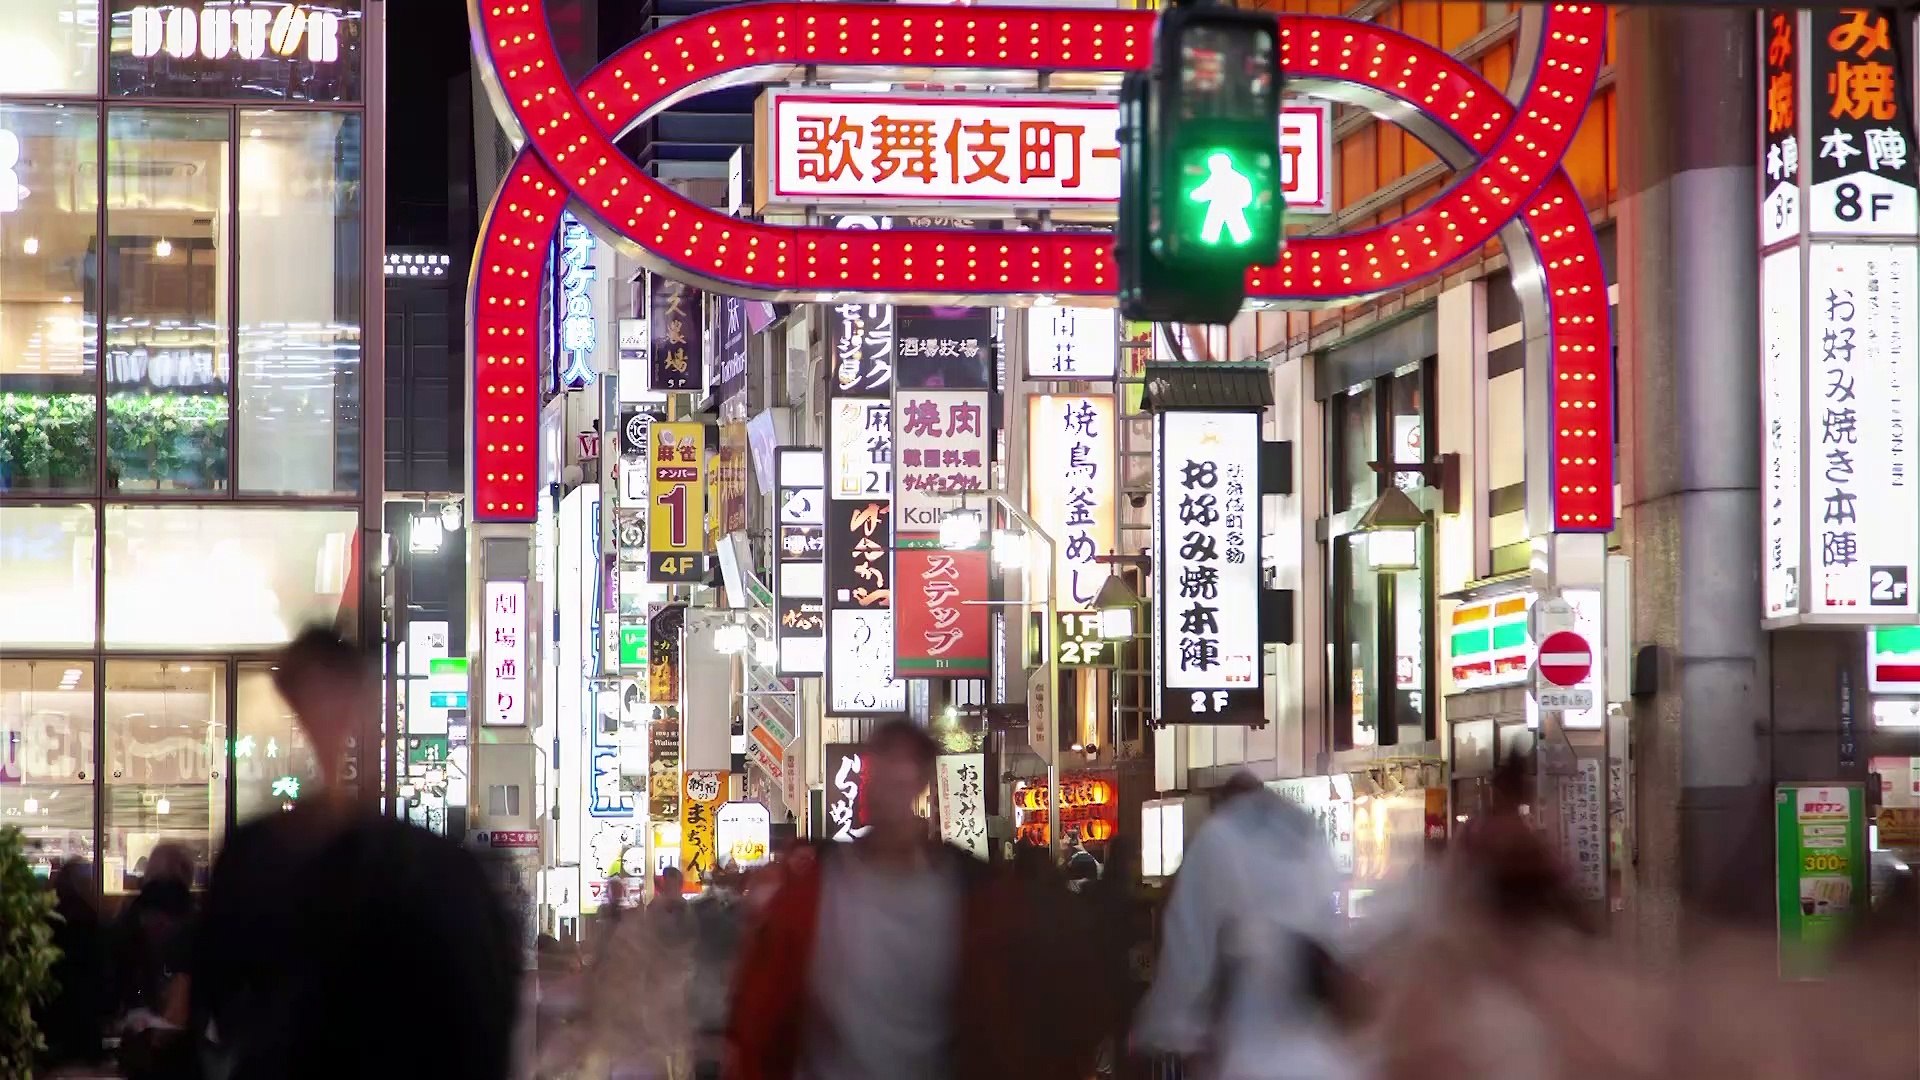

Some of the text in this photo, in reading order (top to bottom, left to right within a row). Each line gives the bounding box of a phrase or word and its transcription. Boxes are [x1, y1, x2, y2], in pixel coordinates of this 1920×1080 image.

[131, 5, 339, 62] DOUTOR
[1827, 9, 1897, 120] み焼
[795, 115, 1303, 193] 歌舞伎町
[1819, 127, 1907, 171] 本陣
[1835, 182, 1893, 222] 8F
[1822, 287, 1858, 568] お好み焼き本陣
[657, 445, 697, 462] 麻雀
[658, 469, 697, 478] ナンバー
[657, 484, 687, 547] 1
[904, 507, 983, 524] Koll
[659, 557, 694, 575] 4F
[1179, 459, 1220, 672] お好み焼本陣
[1871, 570, 1908, 600] 2F
[921, 555, 964, 656] ステップ
[1060, 640, 1104, 664] 2F
[1190, 690, 1229, 713] 2F
